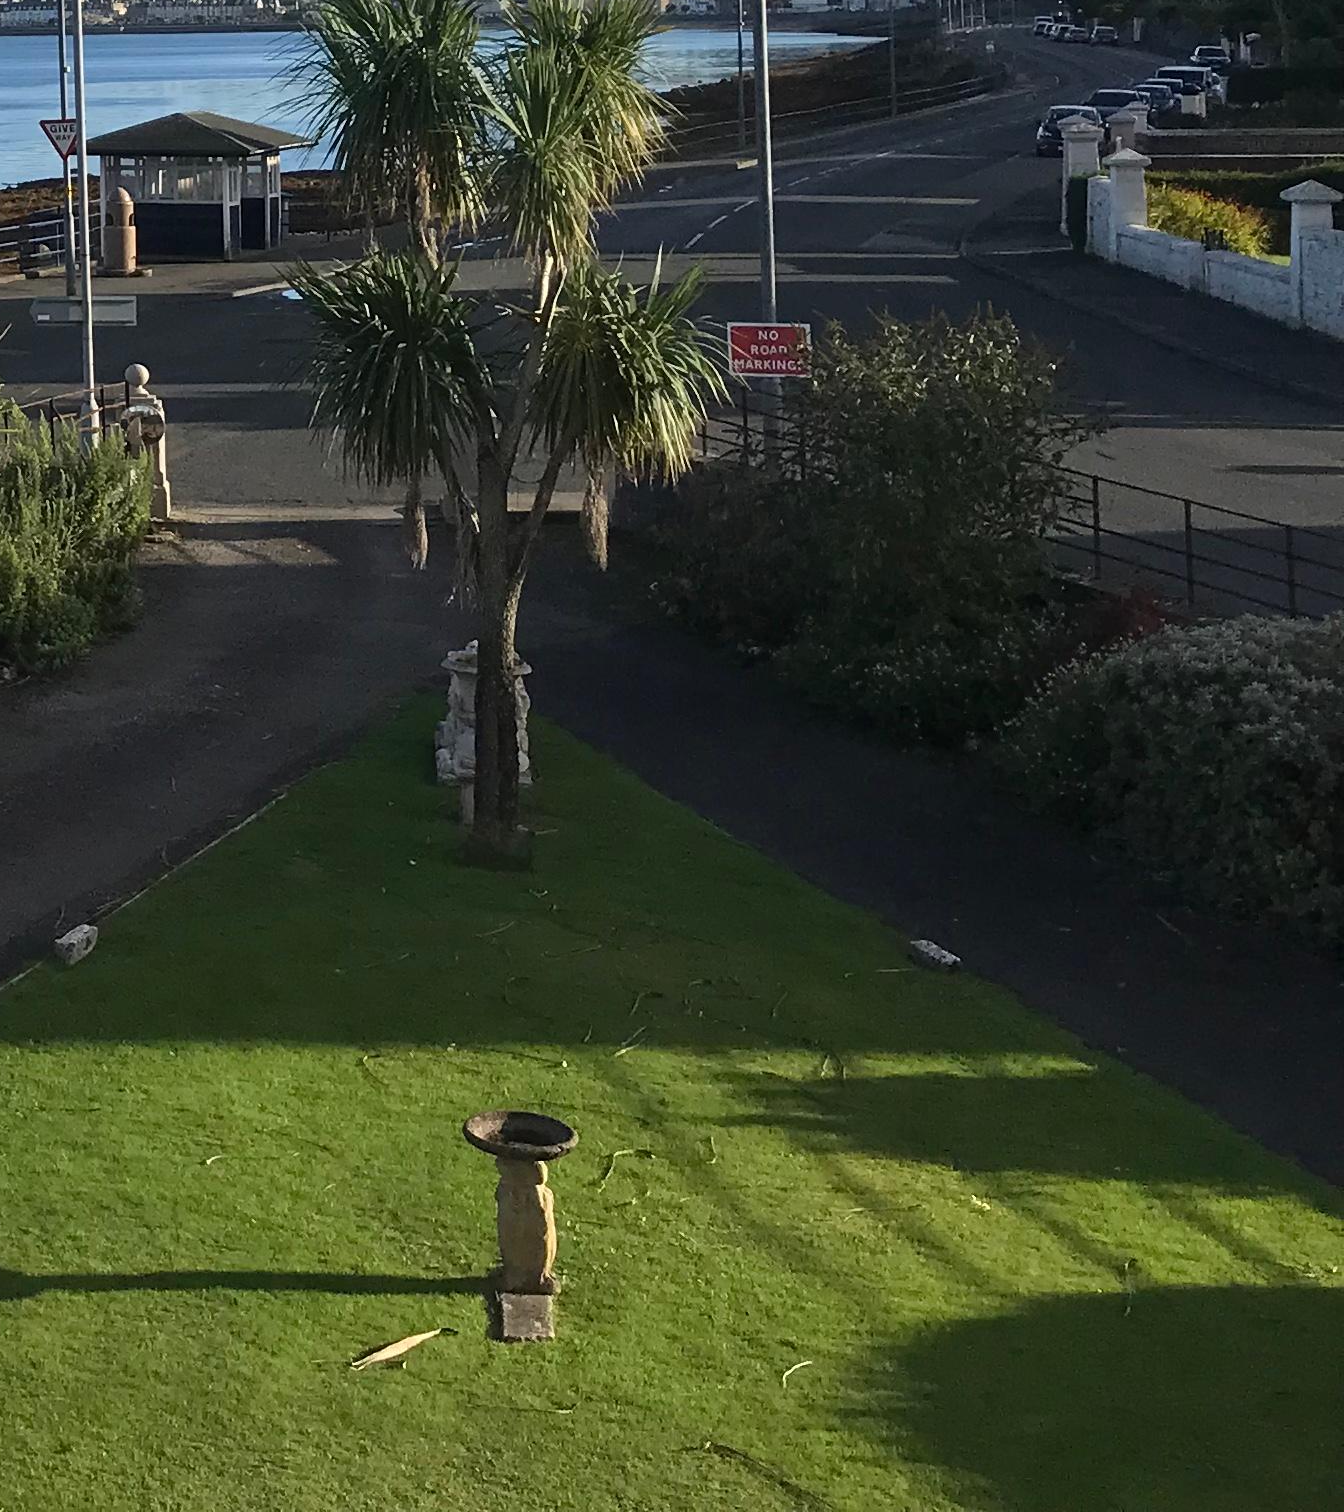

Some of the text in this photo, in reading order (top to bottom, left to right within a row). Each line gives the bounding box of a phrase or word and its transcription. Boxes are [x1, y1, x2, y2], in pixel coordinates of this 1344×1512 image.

[50, 124, 75, 133] GIVE
[758, 330, 779, 341] NO
[750, 344, 788, 355] ROAD
